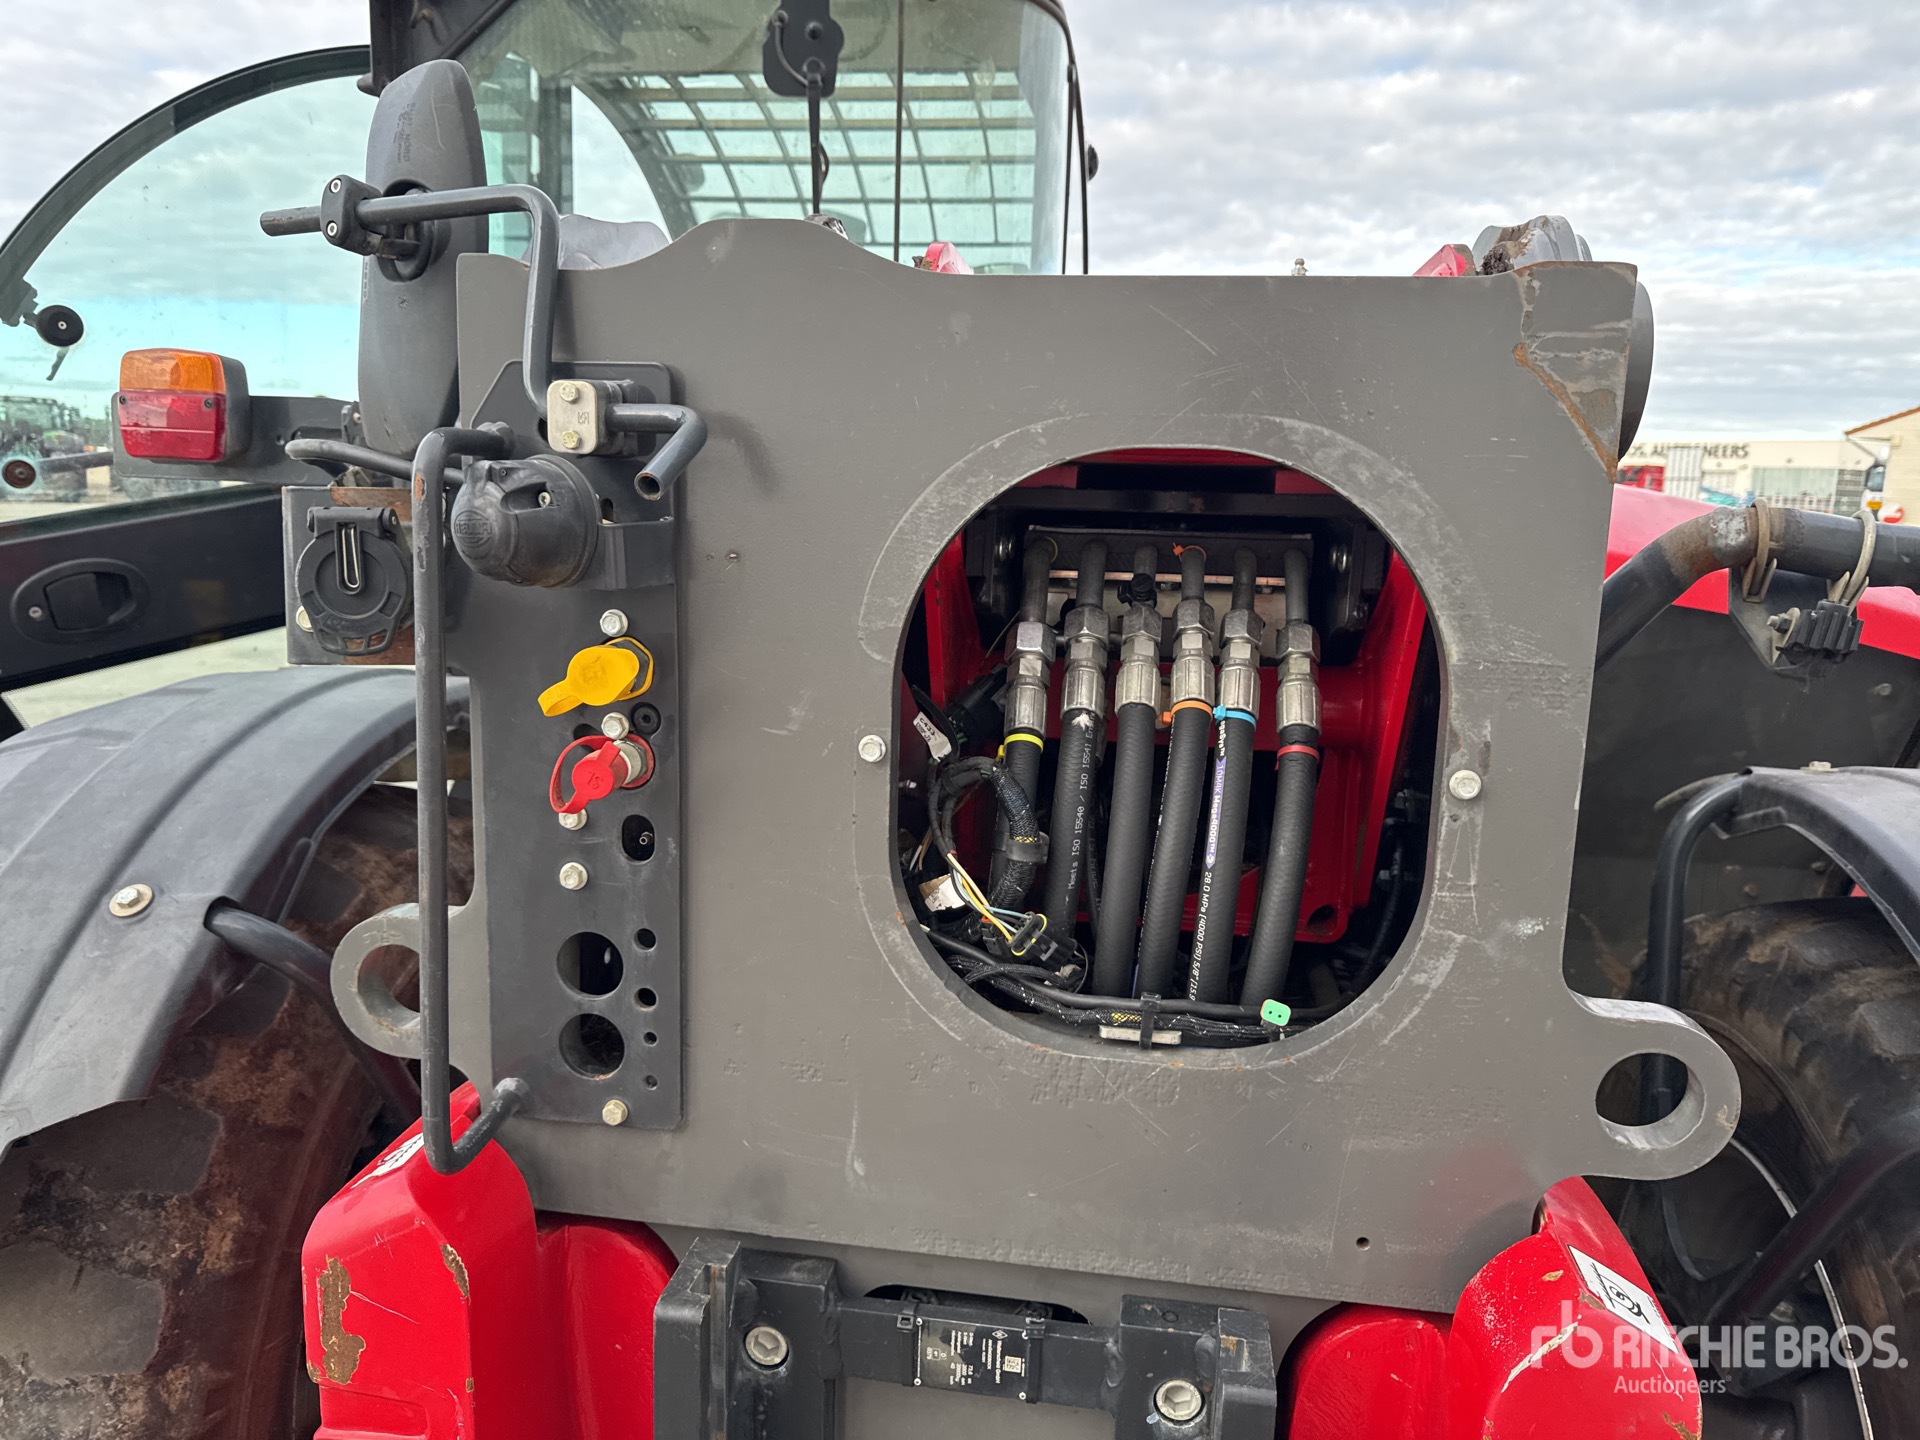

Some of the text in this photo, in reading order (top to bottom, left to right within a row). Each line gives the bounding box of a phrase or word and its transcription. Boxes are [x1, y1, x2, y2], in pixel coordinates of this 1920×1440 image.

[1079, 773, 1089, 790] ISO
[1074, 806, 1085, 834] 15540
[1071, 839, 1081, 857] ISO
[1067, 861, 1078, 889] Meets
[1200, 893, 1209, 913] MPa
